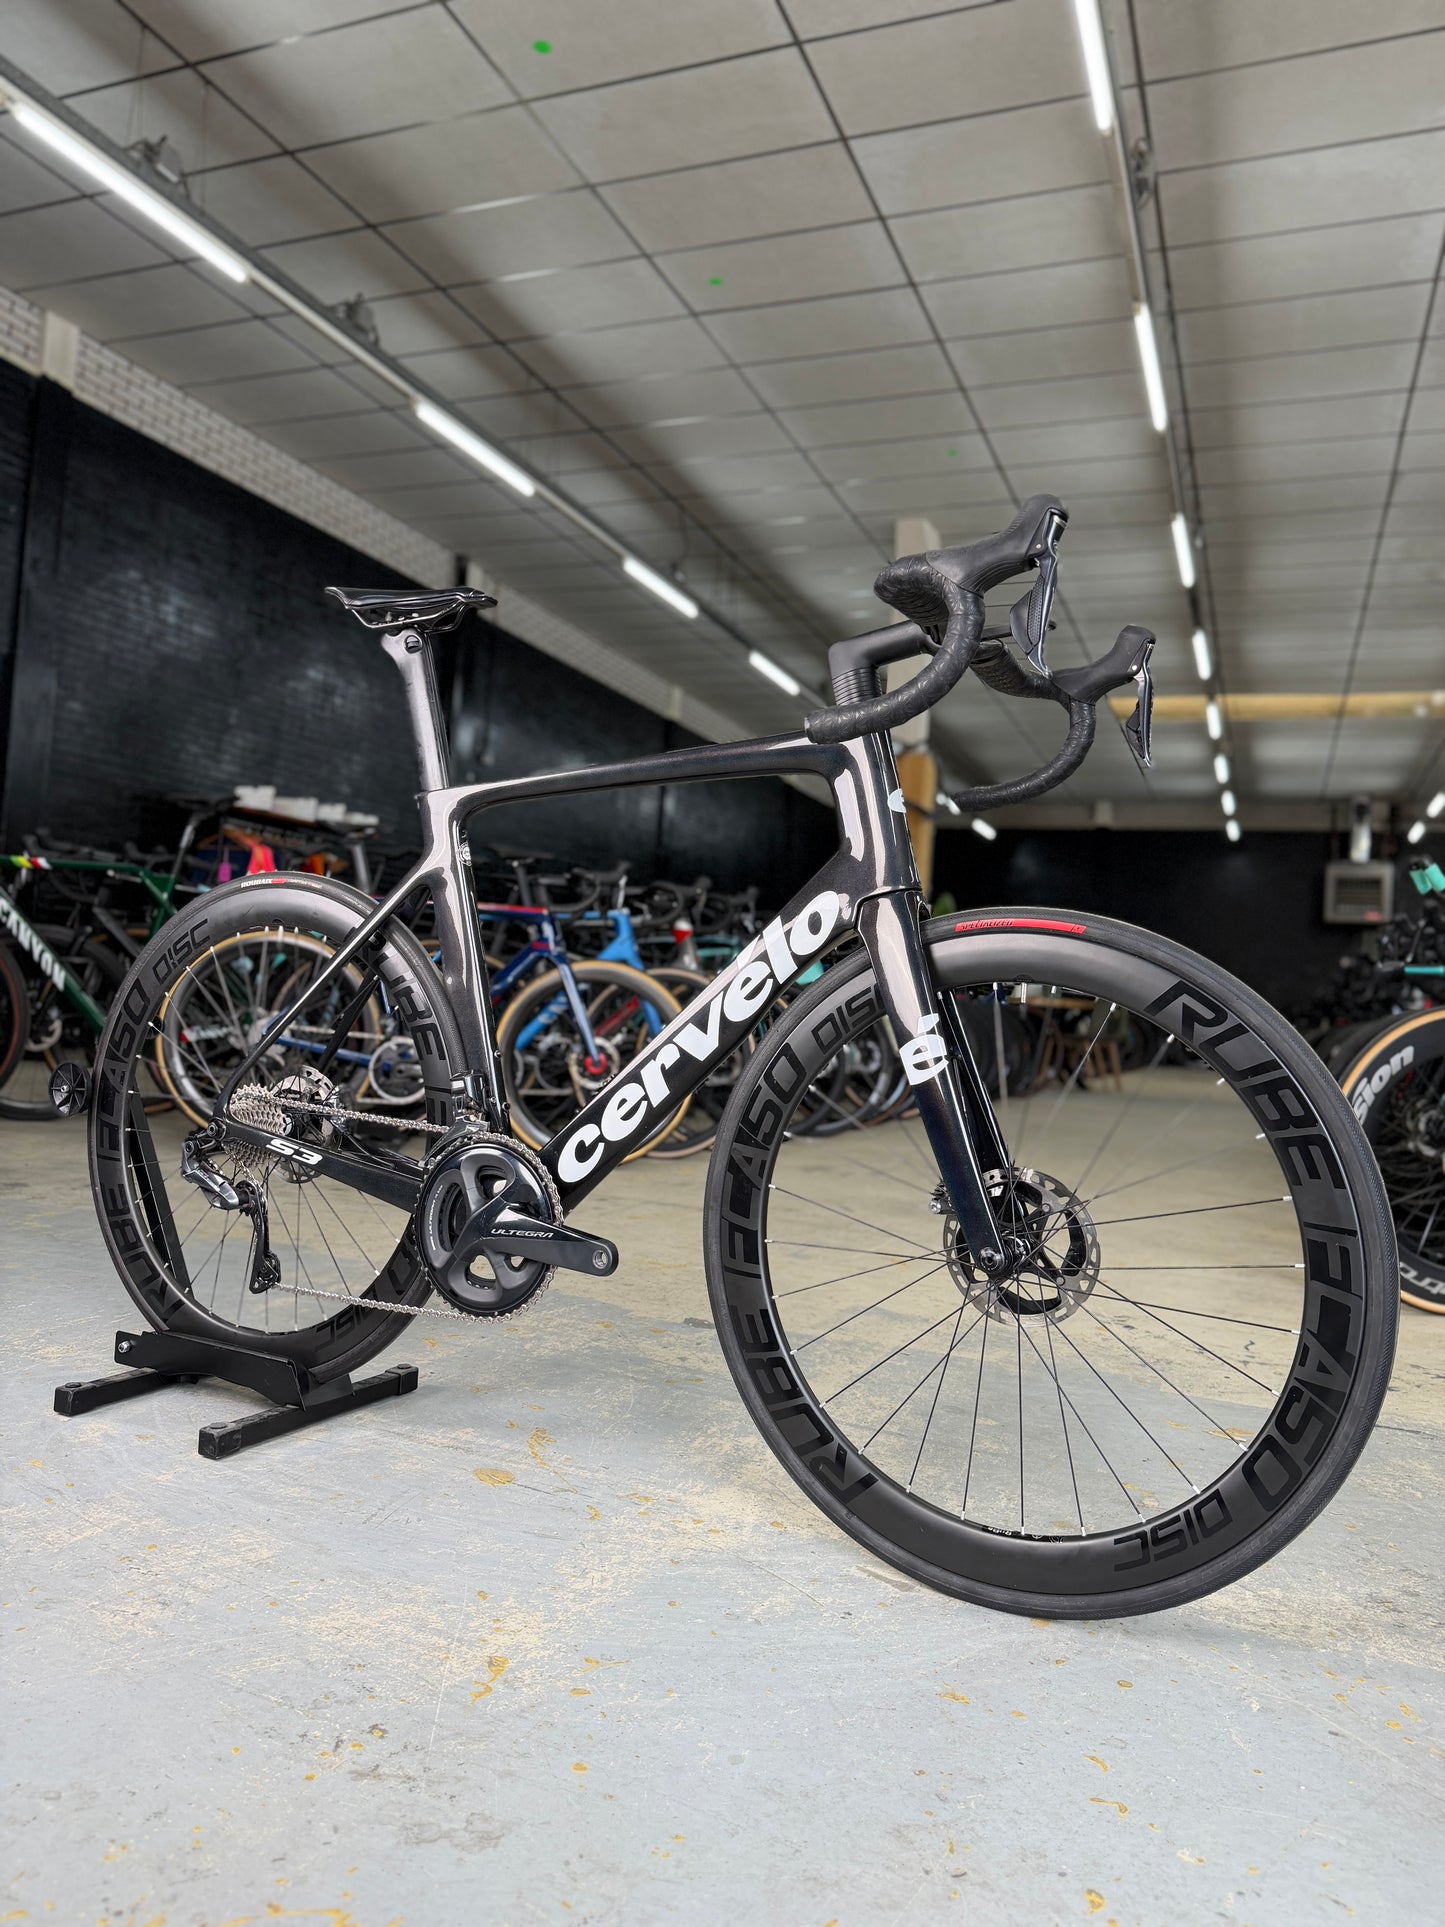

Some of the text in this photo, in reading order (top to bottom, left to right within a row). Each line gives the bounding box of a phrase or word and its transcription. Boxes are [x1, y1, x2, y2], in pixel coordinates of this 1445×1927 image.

[558, 890, 839, 1183] cervélo
[1143, 980, 1347, 1189] RUBE
[1352, 1045, 1415, 1126] sion
[100, 1182, 185, 1322] RUBE
[152, 917, 211, 986] DISC
[266, 1138, 323, 1165] S3
[491, 1228, 554, 1238] ULTEGRA
[729, 1304, 879, 1503] RUBE
[1112, 1488, 1233, 1572] DISC
